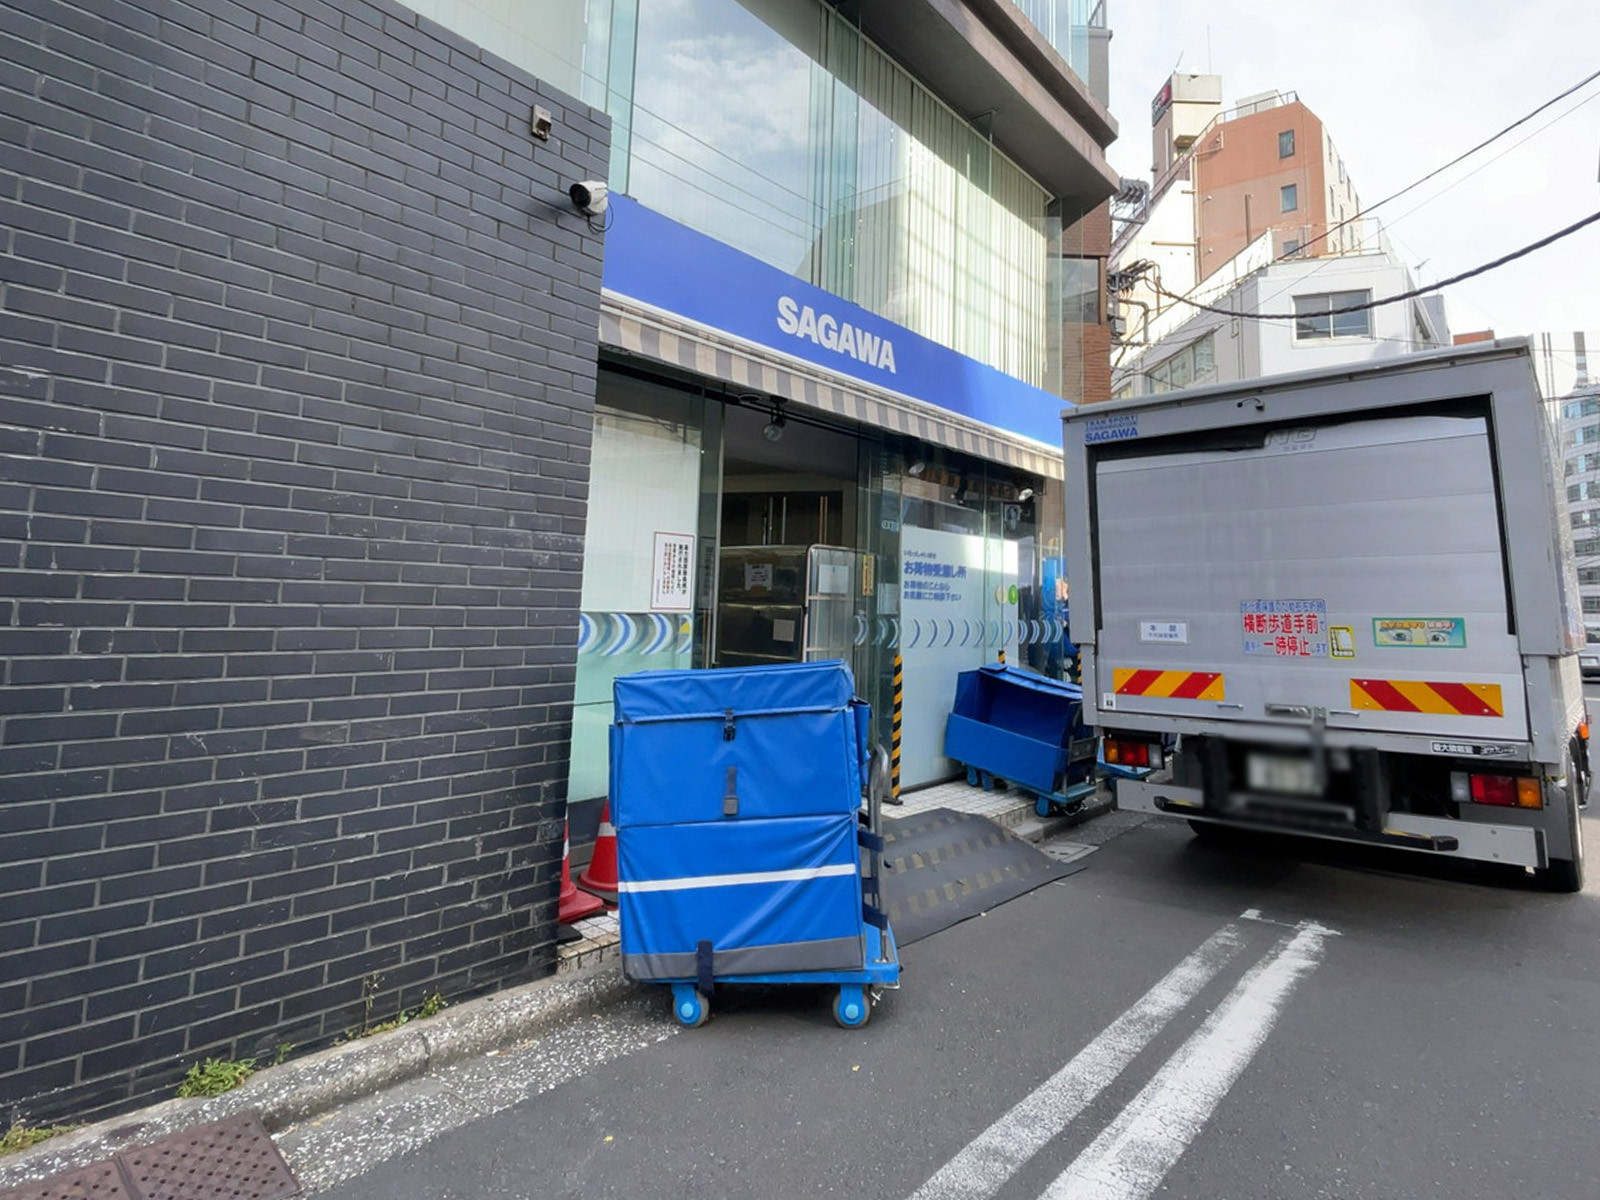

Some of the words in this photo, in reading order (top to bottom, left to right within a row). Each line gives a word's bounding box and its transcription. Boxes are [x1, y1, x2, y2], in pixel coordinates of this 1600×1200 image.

[777, 296, 896, 374] SAGAWA
[1085, 427, 1138, 442] SAGAWA
[1244, 613, 1326, 634] 横断歩道手前で
